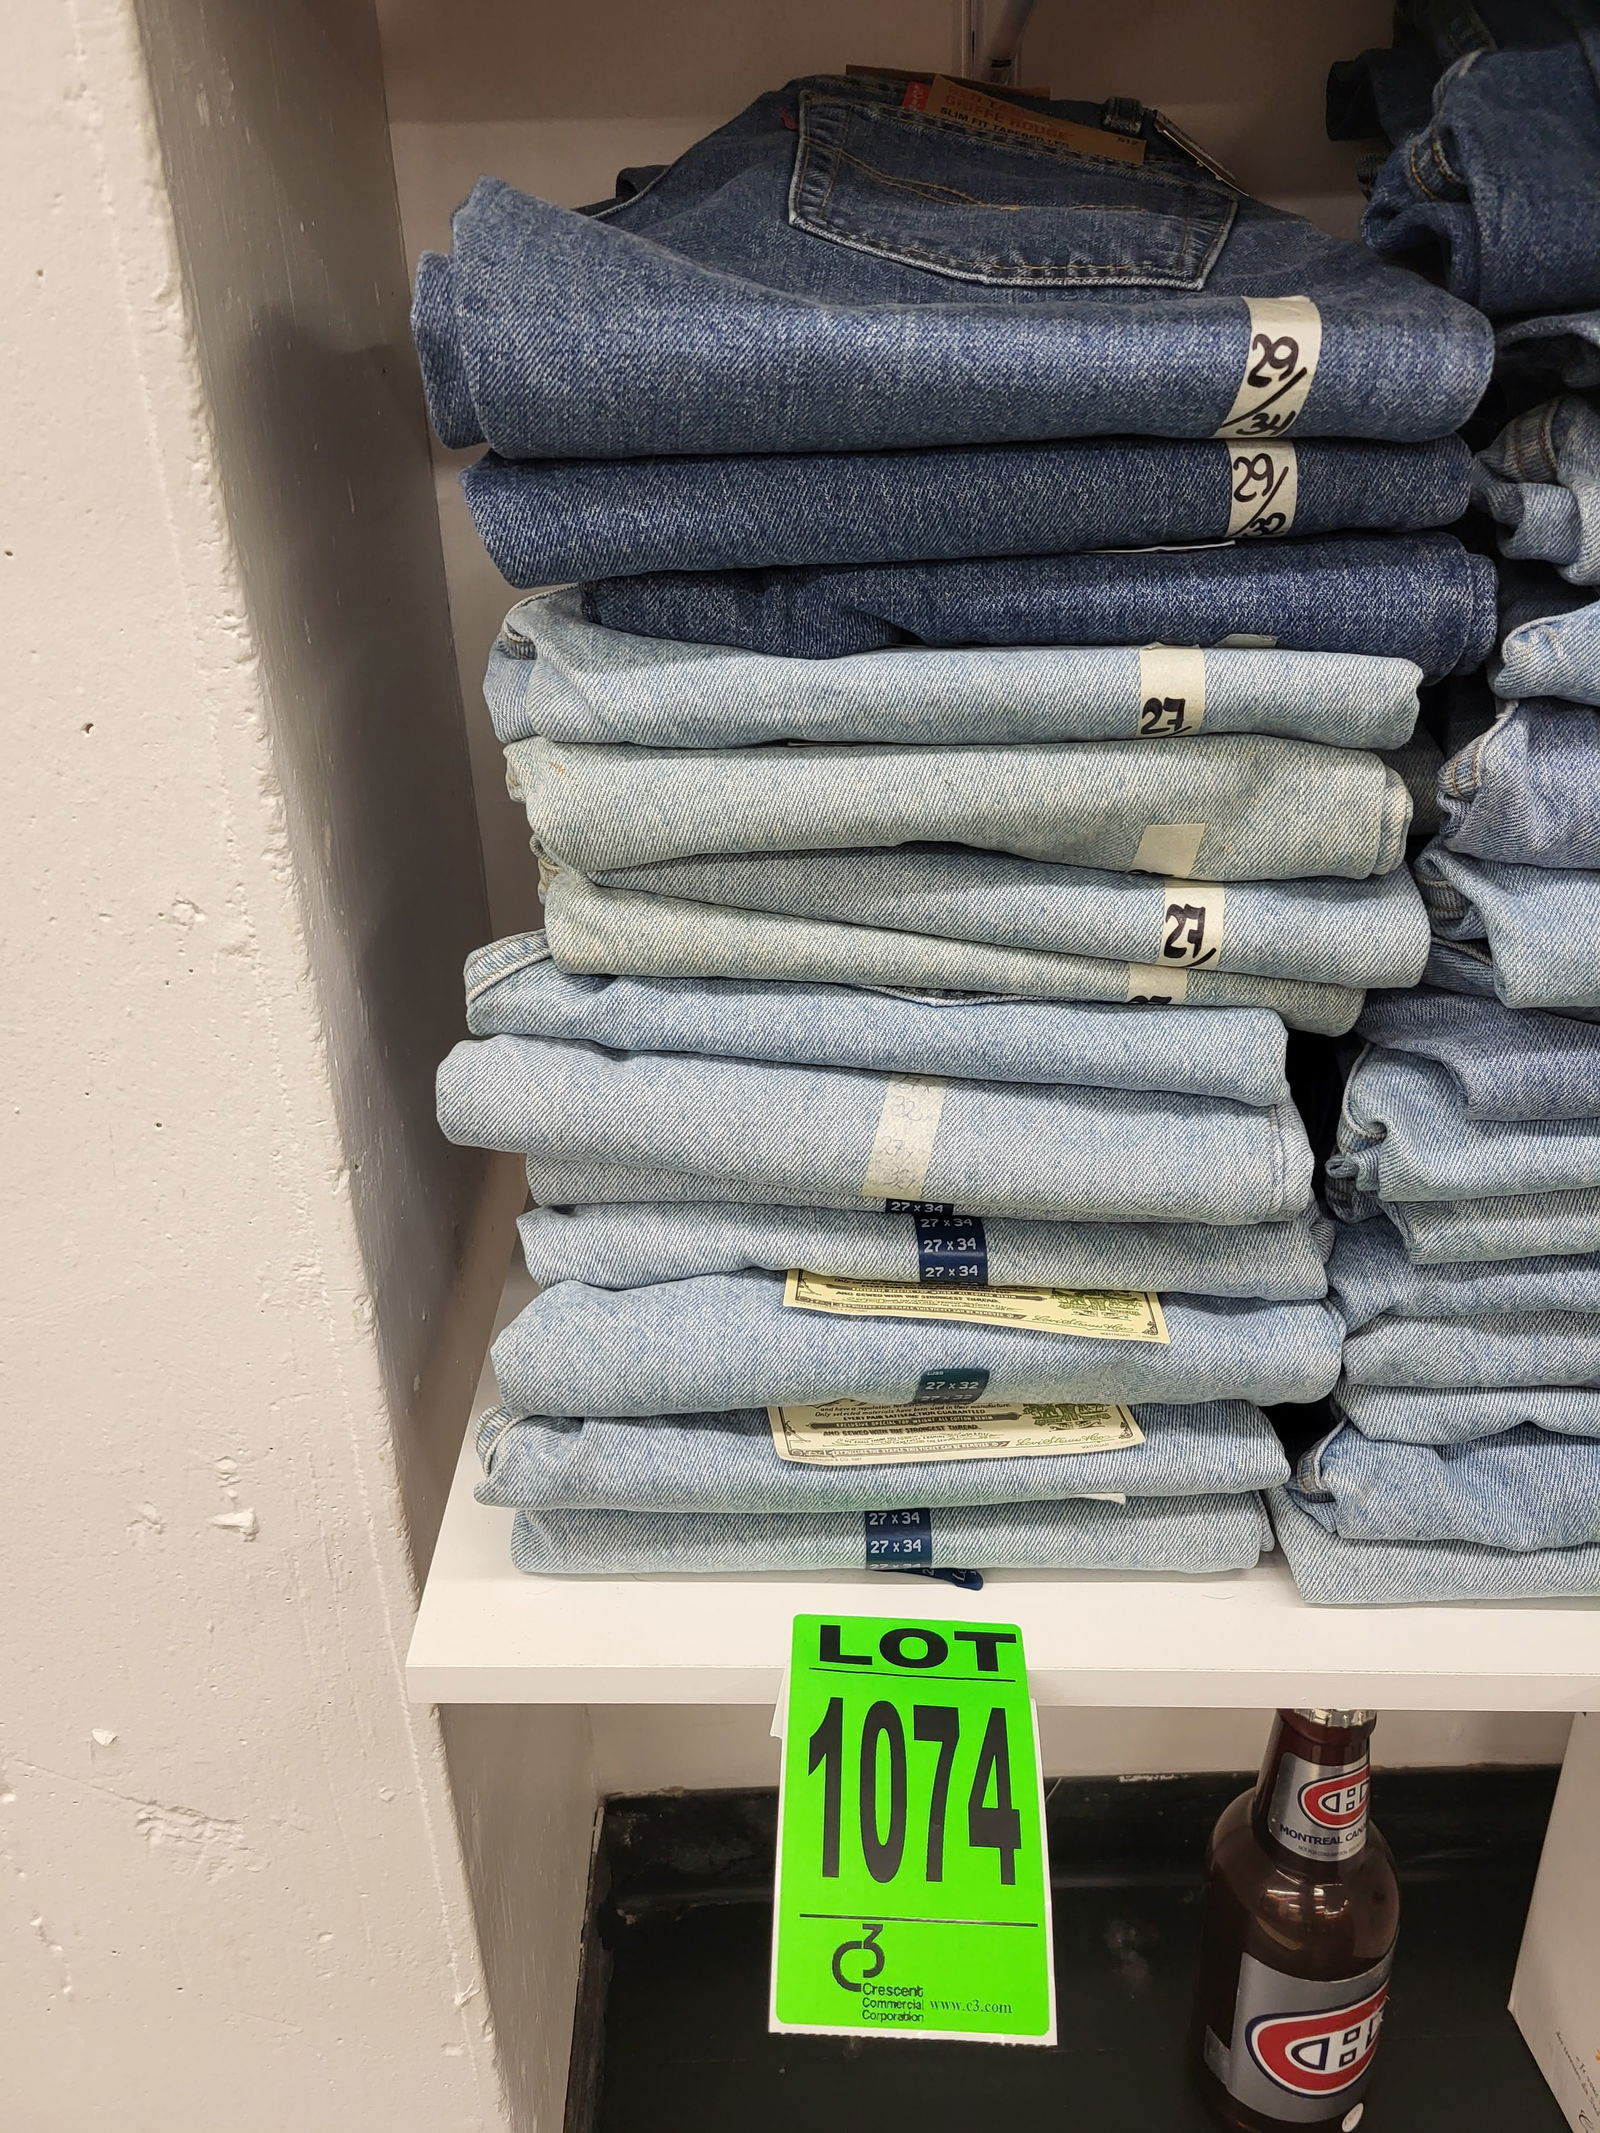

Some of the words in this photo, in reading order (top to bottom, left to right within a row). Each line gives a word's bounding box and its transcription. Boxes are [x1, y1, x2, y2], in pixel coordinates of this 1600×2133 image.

[940, 107, 968, 121] SLIM
[972, 117, 987, 128] FIT
[891, 1202, 910, 1211] 27
[924, 1204, 943, 1213] 34
[920, 1219, 938, 1228] 27
[953, 1219, 973, 1227] 34
[923, 1239, 942, 1253] 27
[947, 1241, 954, 1251] x
[957, 1237, 976, 1251] 34
[925, 1267, 944, 1277] 27
[949, 1268, 955, 1277] x
[959, 1265, 978, 1276] 34
[925, 1382, 945, 1390] 27
[869, 1512, 887, 1526] 27
[892, 1514, 898, 1524] x
[901, 1511, 920, 1524] 34
[870, 1540, 889, 1553] 27
[893, 1542, 900, 1553] x
[903, 1539, 922, 1552] 34
[820, 1625, 1017, 1673] LOT
[808, 1696, 1022, 1885] 1074
[1280, 1823, 1343, 1845] MONTREAL
[862, 1982, 923, 1998] Crescent
[862, 1997, 924, 2011] Commercial
[929, 1999, 1013, 2014] www.c3.com
[862, 2010, 924, 2023] Corporation
